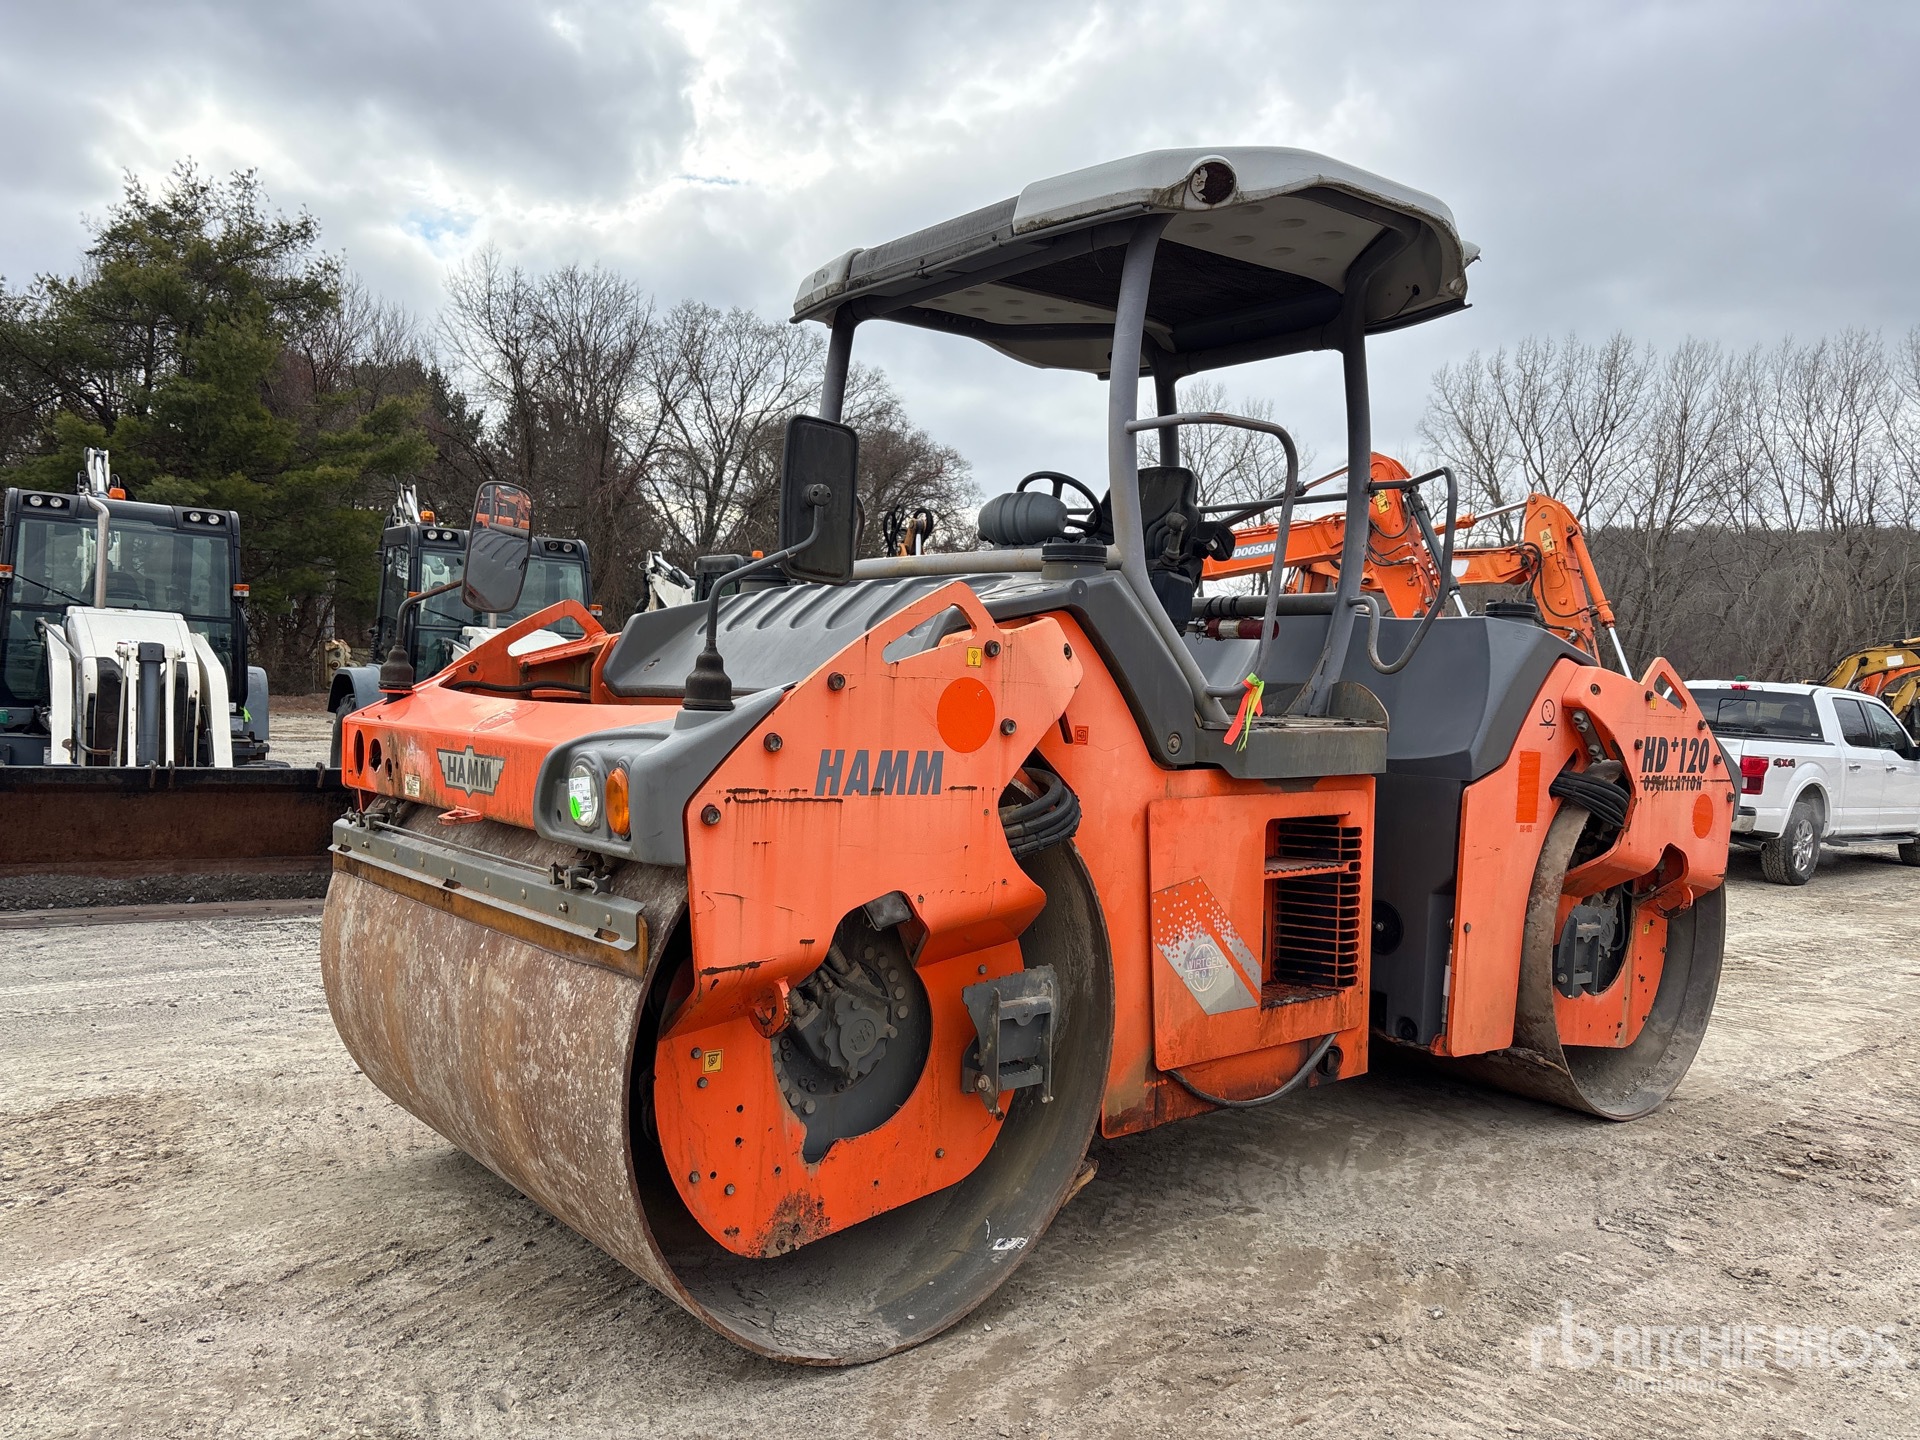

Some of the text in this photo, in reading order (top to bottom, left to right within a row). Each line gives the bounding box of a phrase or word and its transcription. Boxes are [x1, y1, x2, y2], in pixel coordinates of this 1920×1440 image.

[1233, 542, 1276, 558] DOOSAN
[447, 755, 492, 789] HAMM
[814, 749, 944, 796] HAMM
[1643, 775, 1703, 792] OSCILLATION
[1186, 955, 1222, 970] WIRTGEN
[1187, 968, 1220, 980] GROUP
